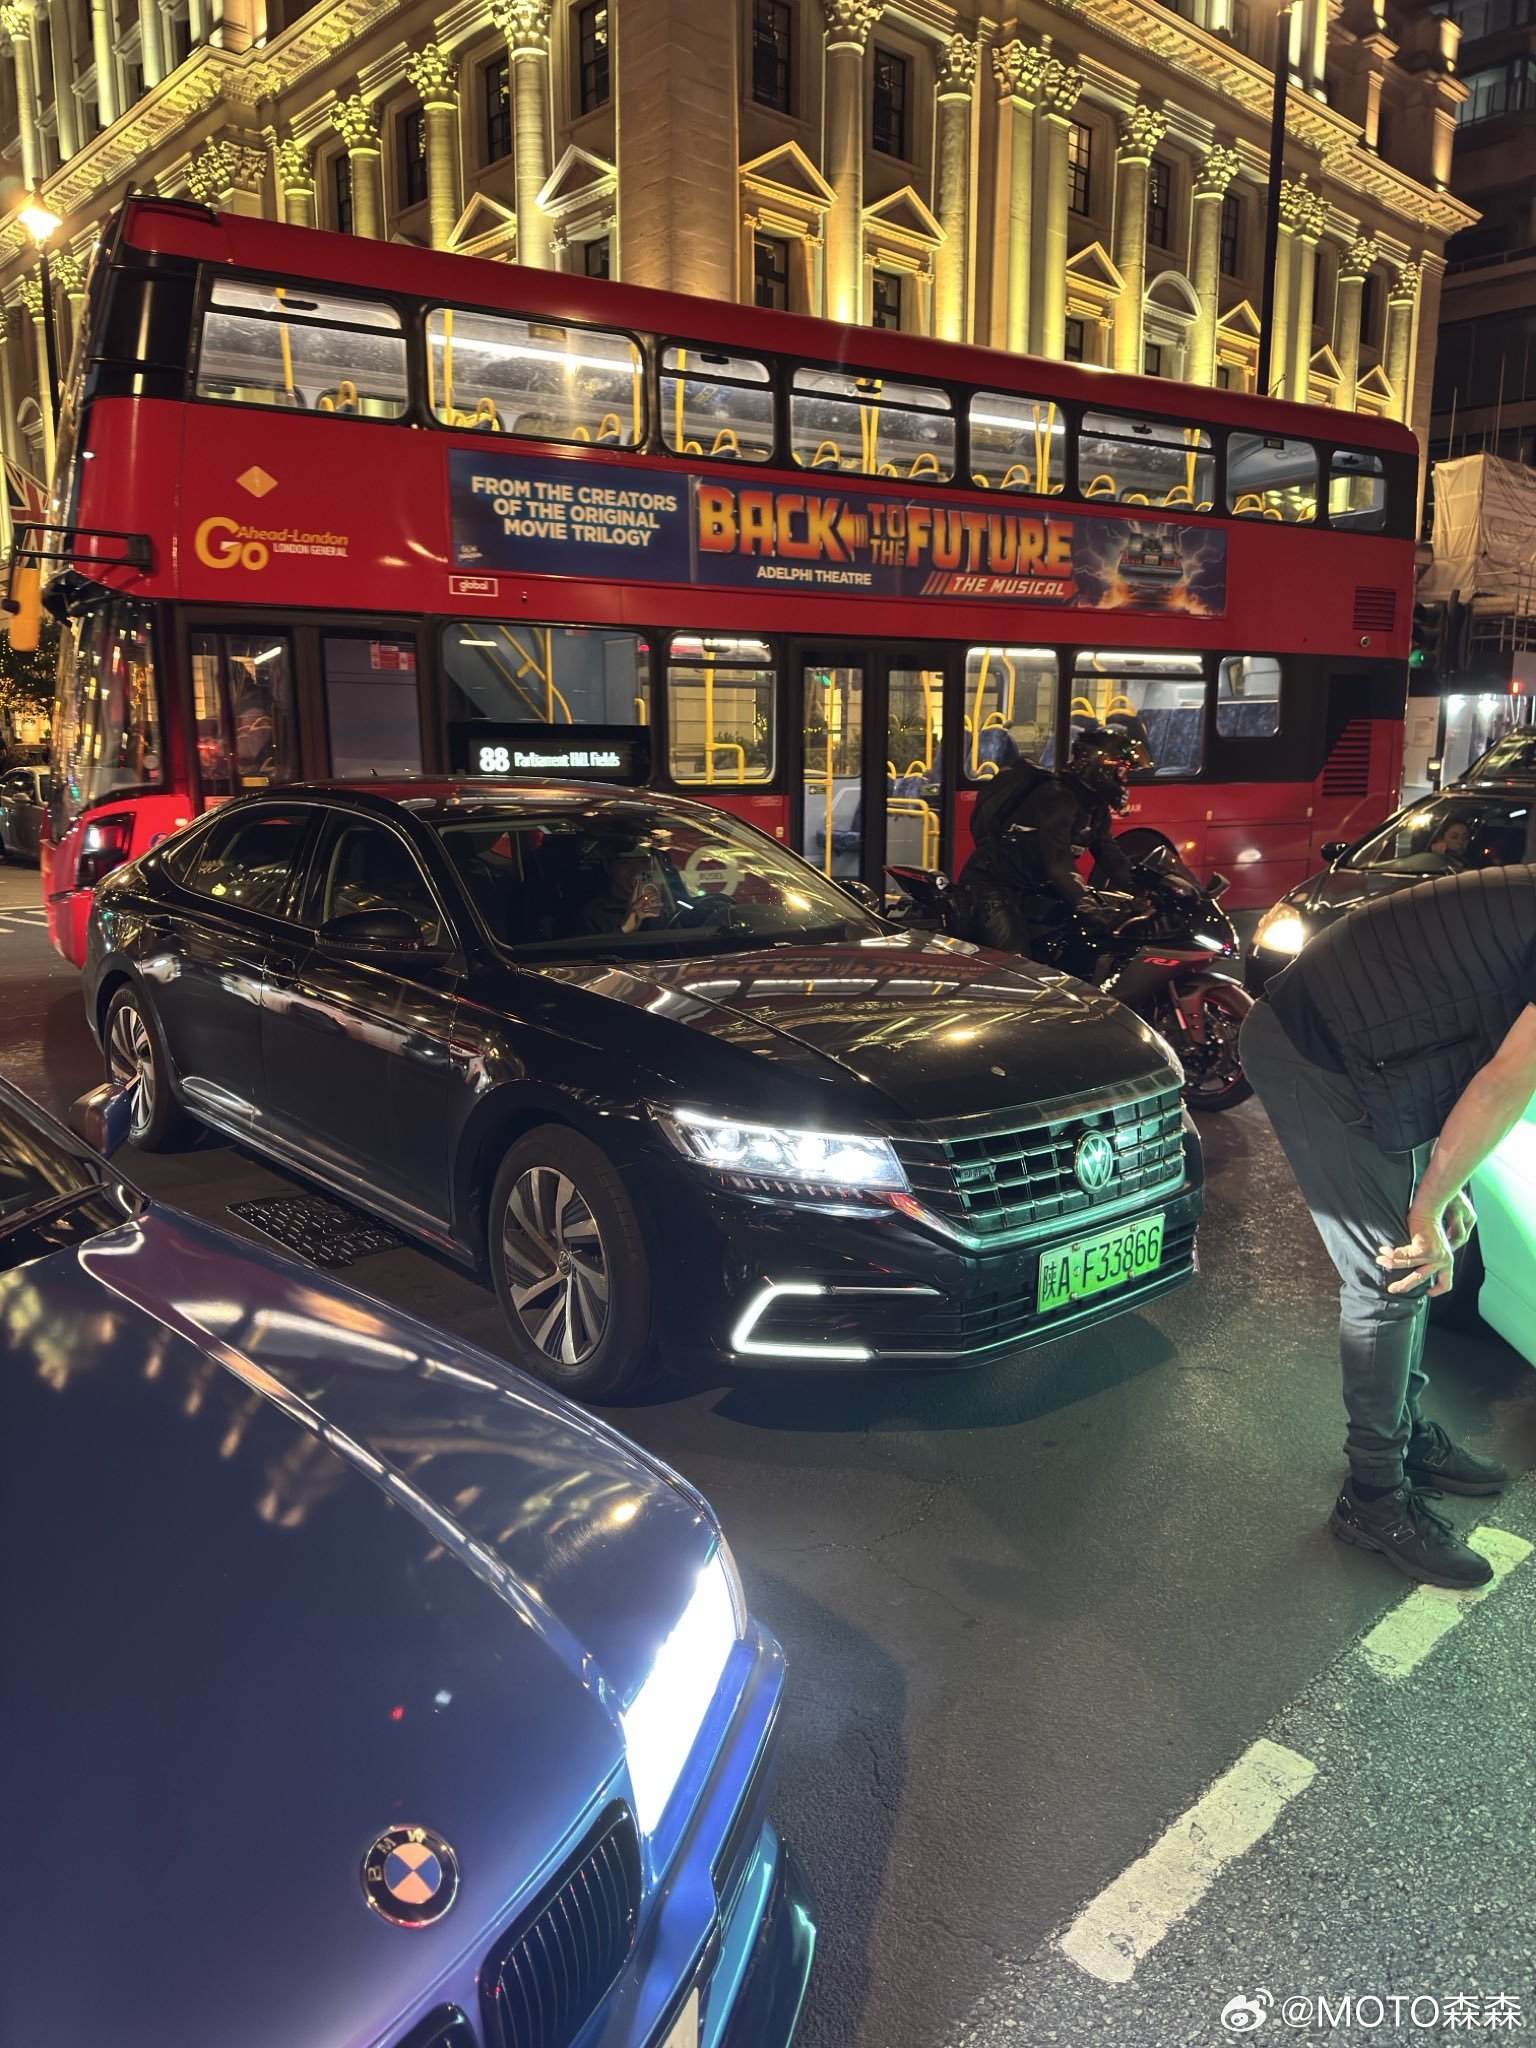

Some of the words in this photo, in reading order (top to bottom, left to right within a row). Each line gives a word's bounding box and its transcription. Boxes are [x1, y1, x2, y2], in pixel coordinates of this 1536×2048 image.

[472, 476, 531, 498] FROM
[535, 482, 574, 502] THE
[578, 487, 677, 511] CREATORS
[494, 498, 522, 515] OF
[527, 501, 565, 520] THE
[570, 505, 660, 529] ORIGINAL
[697, 485, 848, 562] BACK
[868, 503, 906, 538] TO
[195, 516, 269, 570] Go
[237, 526, 349, 546] Ahead-London
[504, 518, 568, 540] MOVIE
[572, 524, 652, 546] TRILOGY
[906, 505, 1074, 577] FUTURE
[273, 543, 310, 554] LONDON
[870, 538, 905, 566] THE
[459, 579, 489, 593] global
[757, 565, 813, 581] ADELPHI
[815, 570, 872, 585] THEATRE
[952, 576, 988, 593] THE
[990, 580, 1064, 596] MUSICAL
[479, 747, 510, 772] 88
